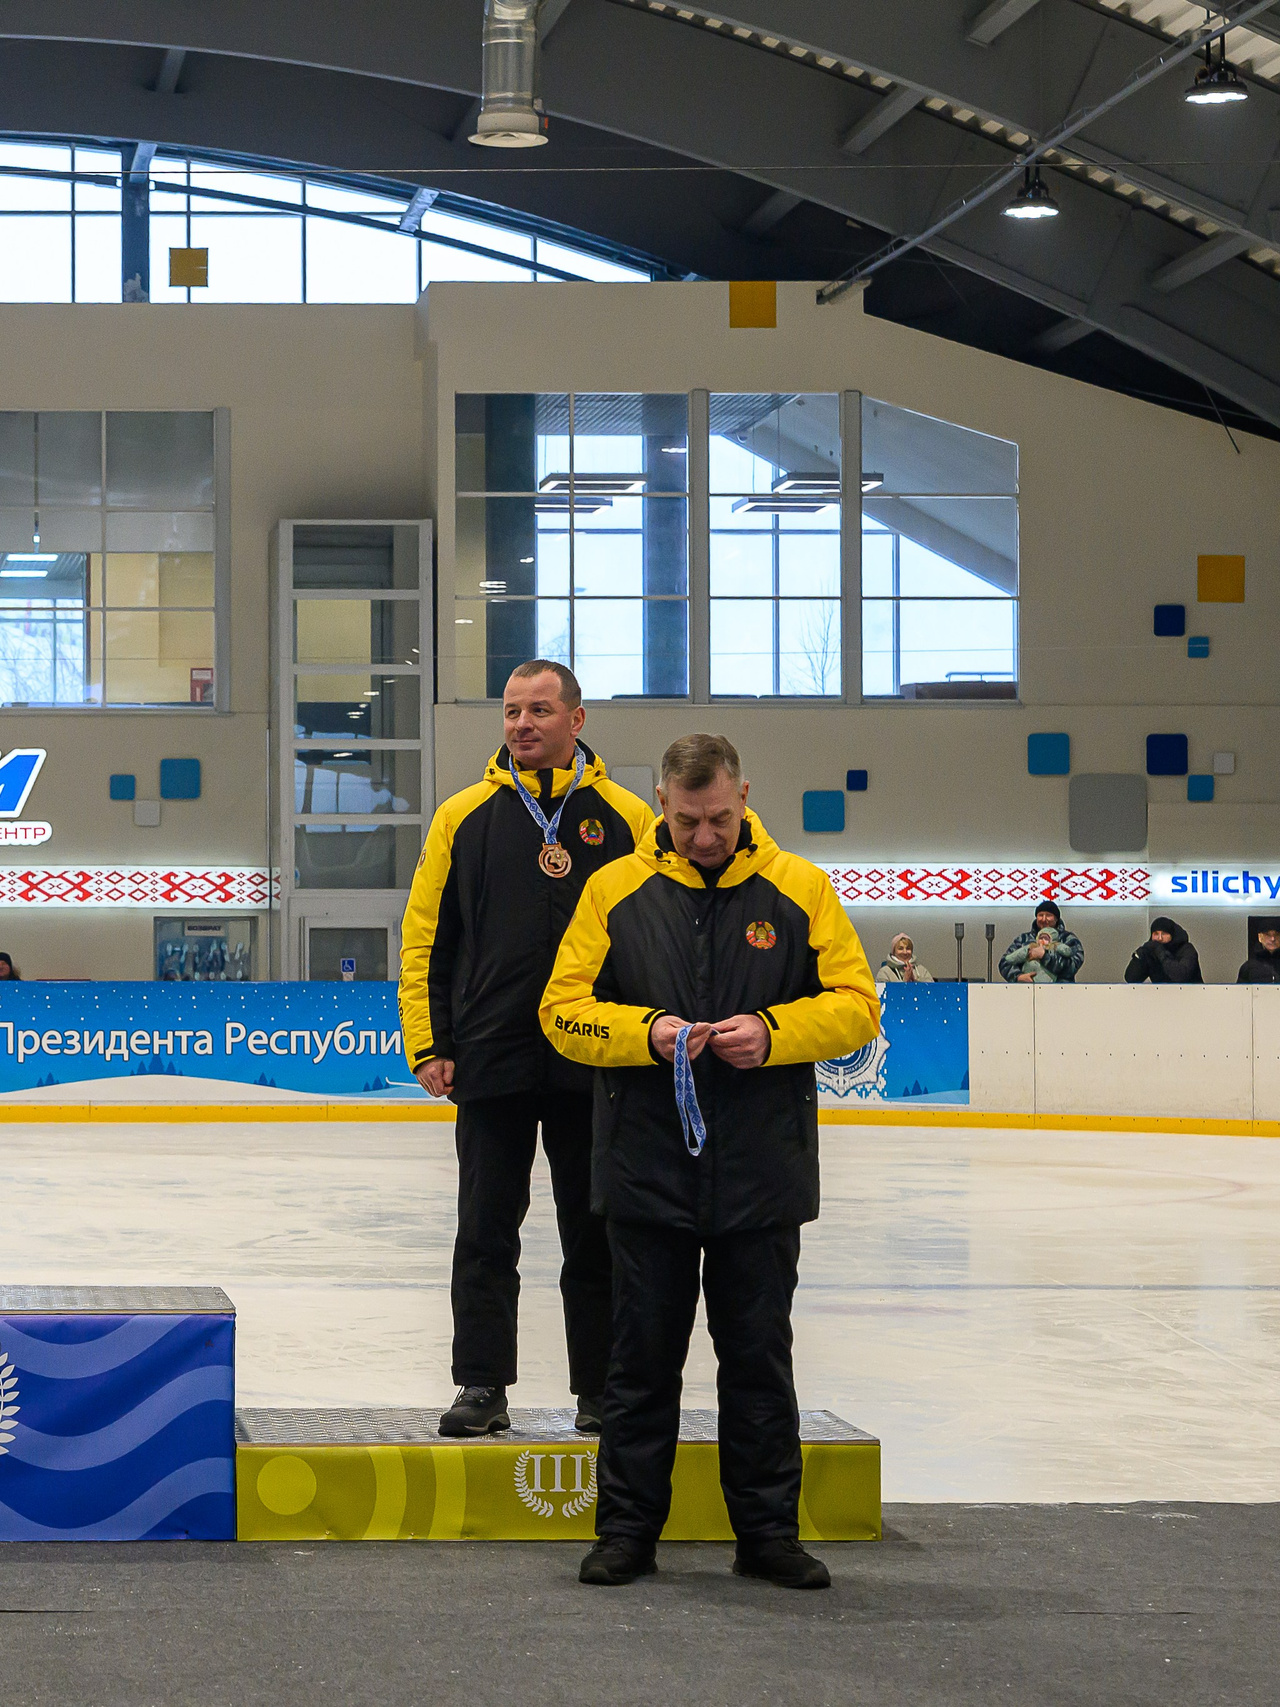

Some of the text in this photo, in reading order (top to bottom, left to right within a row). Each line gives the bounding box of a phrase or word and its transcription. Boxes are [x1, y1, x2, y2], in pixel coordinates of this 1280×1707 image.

[1171, 870, 1280, 899] silichy
[225, 1020, 402, 1064] Республи
[555, 1014, 610, 1040] BEARUS
[528, 1454, 587, 1492] III
